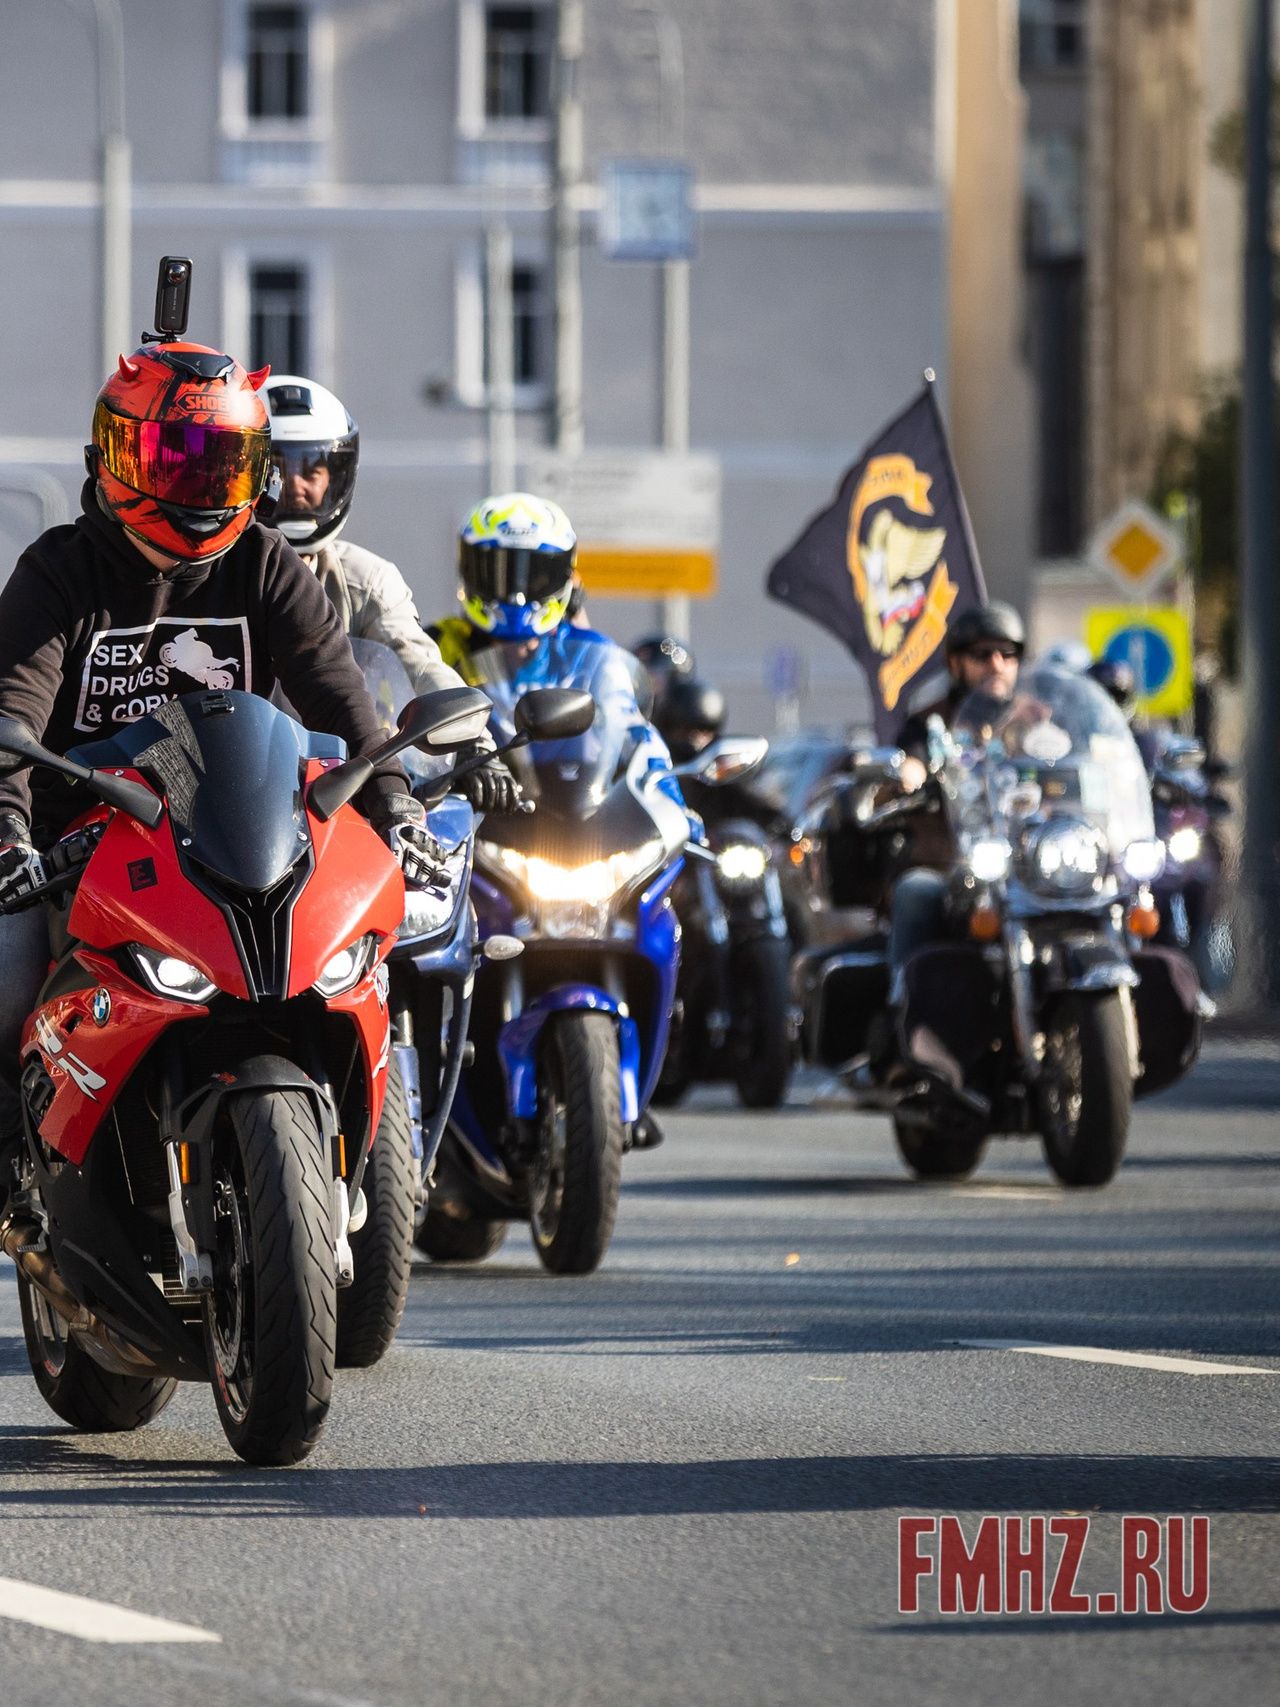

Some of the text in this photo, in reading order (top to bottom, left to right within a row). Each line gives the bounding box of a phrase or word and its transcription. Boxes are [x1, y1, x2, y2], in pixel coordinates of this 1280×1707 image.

[93, 643, 145, 667] SEX
[90, 664, 170, 697] DRUGS
[85, 703, 104, 723] &
